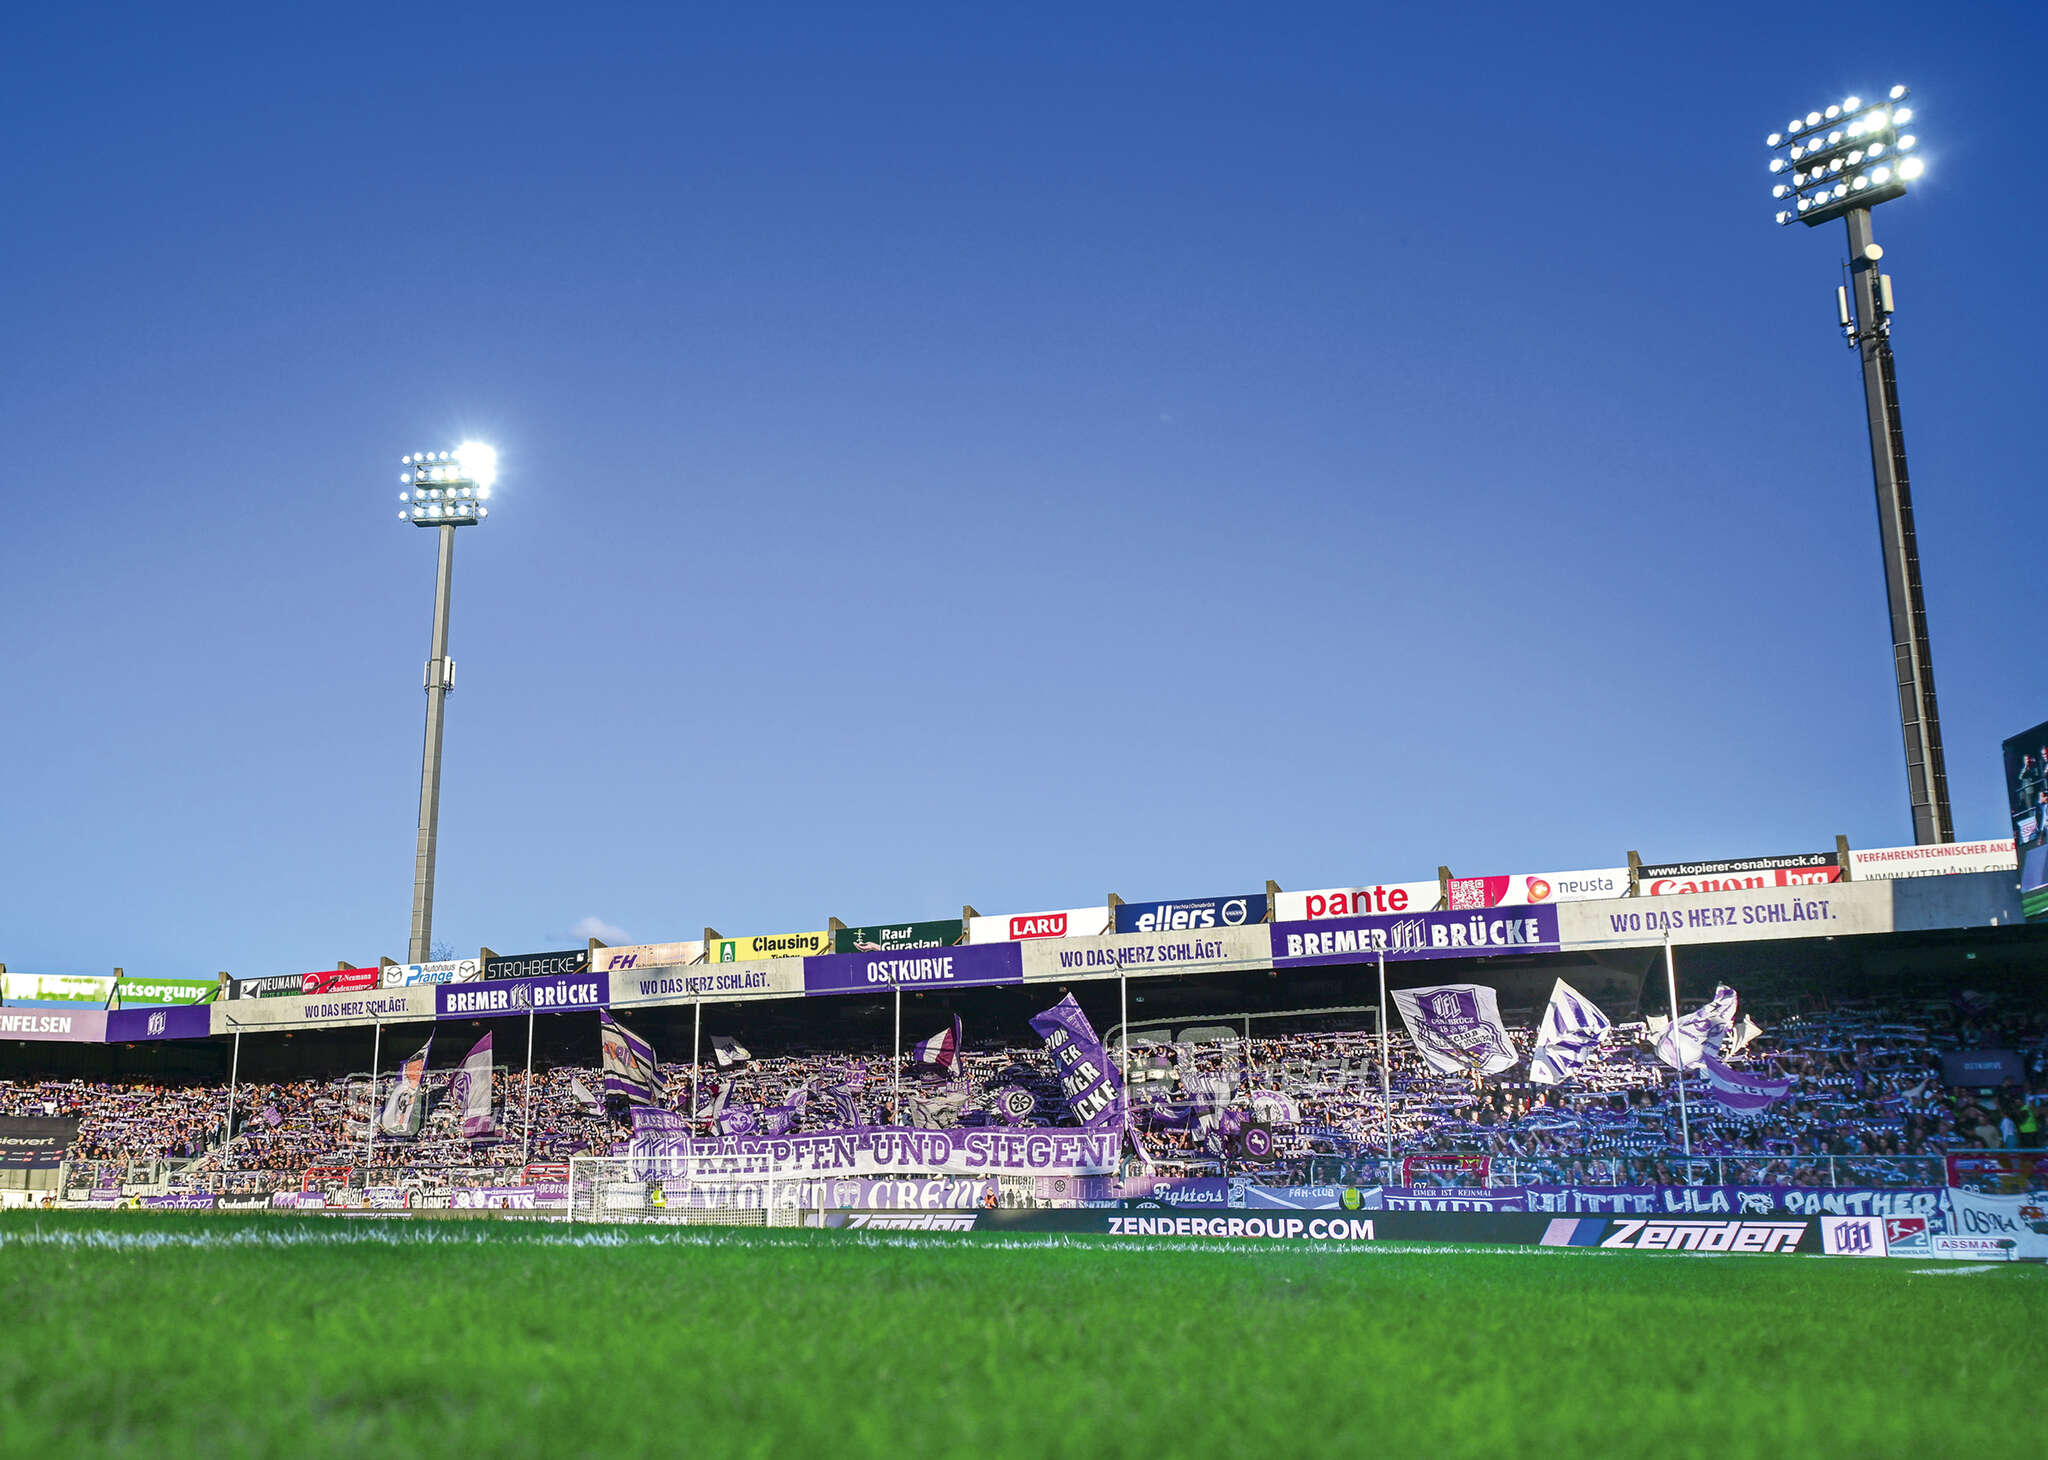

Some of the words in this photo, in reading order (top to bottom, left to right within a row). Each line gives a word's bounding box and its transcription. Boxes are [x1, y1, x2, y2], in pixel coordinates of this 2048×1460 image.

[1856, 844, 1988, 863] VERFAHRENSTECHNISCHER
[1647, 854, 1826, 877] www.kopierer-osnabrueck.de
[1558, 876, 1614, 894] neusta
[1305, 885, 1409, 920] pante
[1013, 916, 1065, 937] LARU
[1135, 905, 1216, 932] ellers
[1610, 912, 1641, 933] WO
[1645, 910, 1684, 932] DAS
[1688, 906, 1737, 928] HERZ
[1742, 897, 1837, 924] SCHLÄGT.
[752, 935, 820, 953] Clausing
[881, 926, 913, 940] Rauf
[1286, 927, 1391, 957] BREMER
[1431, 914, 1541, 948] BRÜCKE
[608, 953, 638, 970] FH
[1060, 951, 1084, 969] WO
[1087, 948, 1116, 967] DAS
[1117, 946, 1156, 965] HERZ
[1157, 938, 1229, 962] SCHLÄGT.
[406, 965, 453, 987] Prange
[422, 963, 456, 972] Autohaus
[487, 956, 576, 979] STROHBECKE
[866, 956, 955, 983] OSTKURVE
[117, 981, 208, 1002] ntsorgung
[261, 975, 303, 991] NEUMANN
[639, 980, 658, 995] WO
[660, 978, 684, 994] DAS
[686, 975, 715, 992] HERZ
[716, 970, 771, 989] SCHLÄGT.
[304, 1004, 320, 1019] WO
[321, 1003, 340, 1017] DAS
[341, 1001, 364, 1016] HERZ
[365, 996, 409, 1015] SCHLÄGT.
[446, 991, 509, 1013] BREMER
[533, 981, 599, 1007] BRÜCKE
[1060, 1043, 1083, 1067] ER
[693, 1135, 858, 1175] KÄMPFEN
[870, 1131, 952, 1168] UND
[964, 1131, 1117, 1169] SIEGEN!
[1153, 1182, 1224, 1205] Fighters
[1412, 1188, 1437, 1197] EIMER
[1441, 1189, 1453, 1197] IST
[1663, 1189, 1731, 1214] LILA
[1107, 1216, 1376, 1241] ZENDERGROUP.COM
[1834, 1220, 1873, 1254] VFL
[1941, 1240, 2001, 1250] ASSMAN
